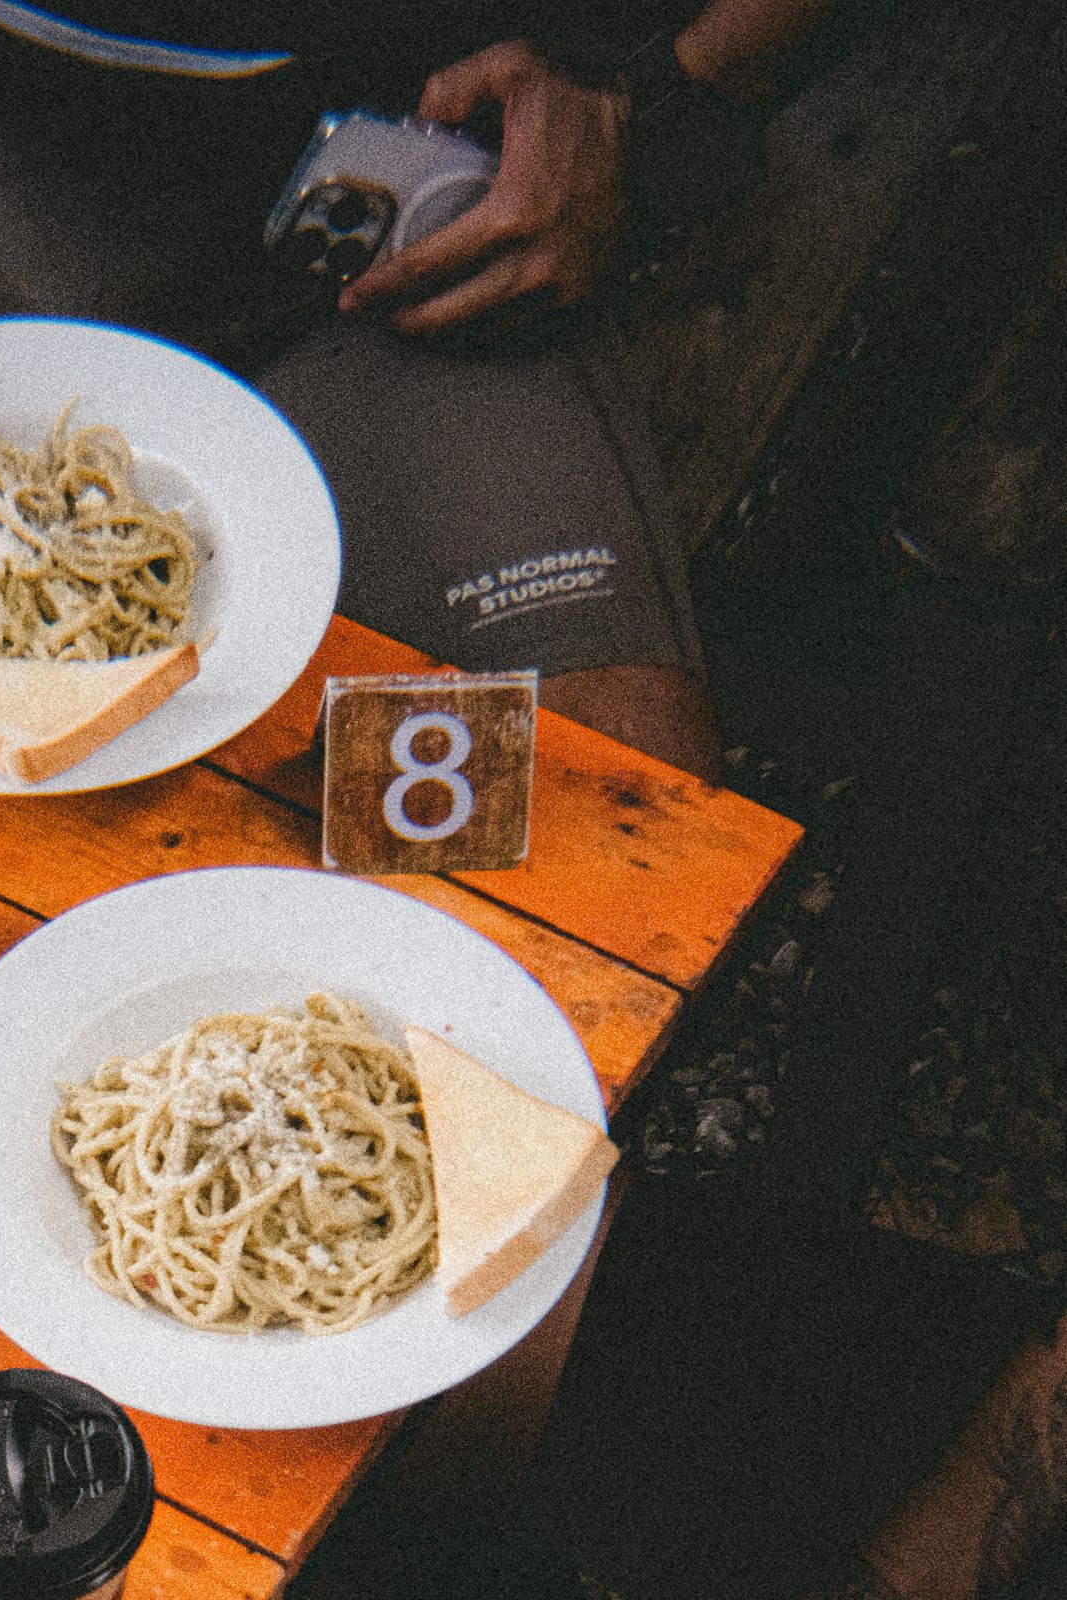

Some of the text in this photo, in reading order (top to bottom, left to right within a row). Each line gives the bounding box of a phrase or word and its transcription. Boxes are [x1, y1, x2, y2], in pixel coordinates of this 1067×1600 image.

[445, 545, 617, 608] PAS NORMAL
[384, 711, 474, 842] 8
